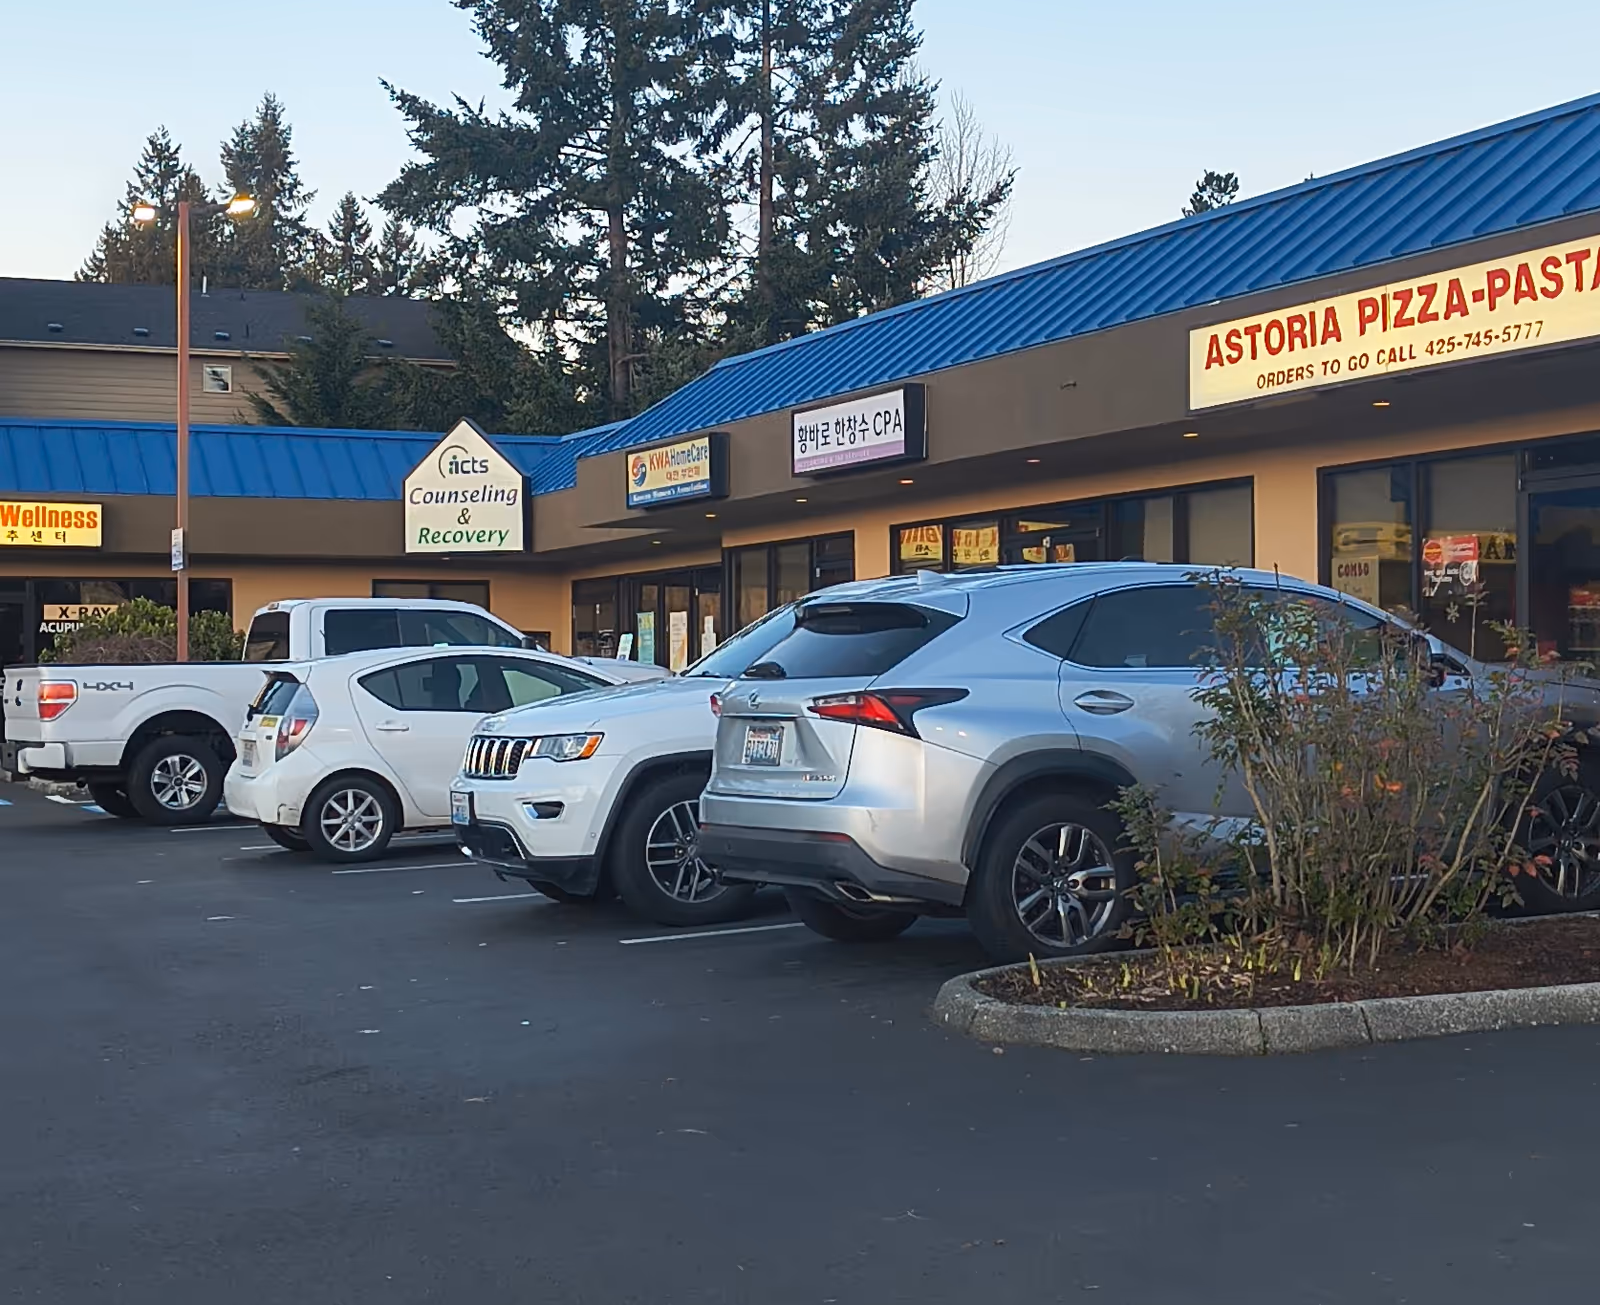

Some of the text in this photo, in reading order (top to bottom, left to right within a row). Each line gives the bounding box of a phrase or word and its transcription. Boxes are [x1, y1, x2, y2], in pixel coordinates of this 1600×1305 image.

[1205, 306, 1342, 370] ASTORIA
[1257, 320, 1544, 389] ORDERS TO GO CALL 425-745-5777
[798, 408, 902, 454] 황바로 한창수 CPA
[409, 485, 518, 506] Counseling
[0, 505, 98, 529] Wellness
[457, 507, 471, 525] &
[417, 527, 510, 547] Recovery
[1338, 562, 1369, 578] COMBO
[39, 621, 84, 633] ACUPU
